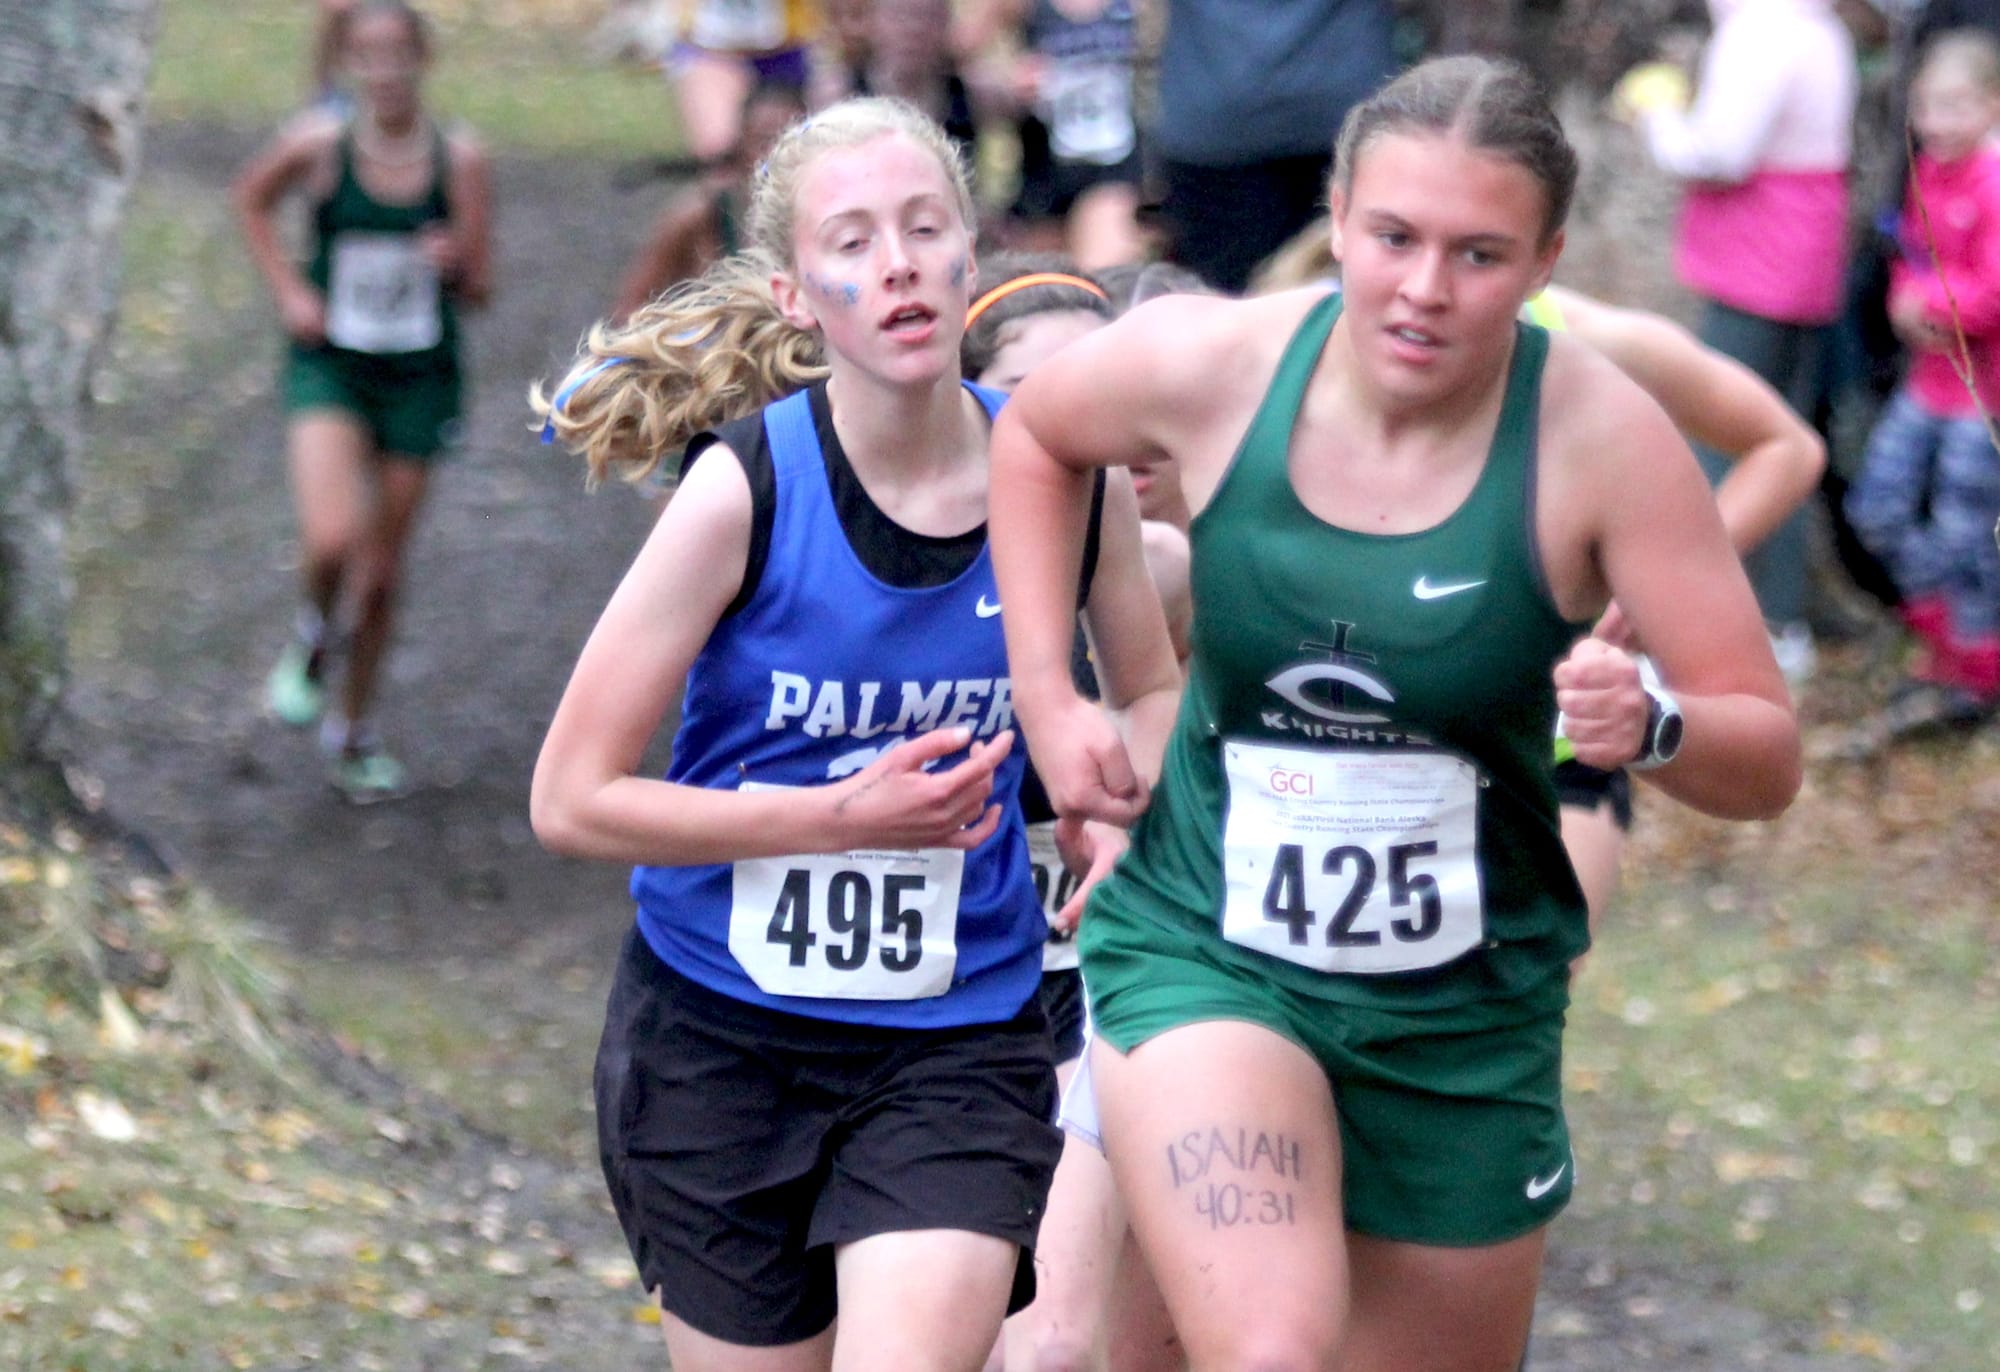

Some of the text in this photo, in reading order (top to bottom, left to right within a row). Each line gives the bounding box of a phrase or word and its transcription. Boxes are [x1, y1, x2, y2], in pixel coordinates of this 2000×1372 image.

[1269, 770, 1314, 796] GCI
[1374, 815, 1396, 823] Bank
[1397, 815, 1427, 823] Alaska
[766, 869, 926, 973] 495
[1262, 840, 1442, 948] 425
[1168, 1127, 1300, 1188] ISAIAH
[1195, 1183, 1295, 1231] 40:31
